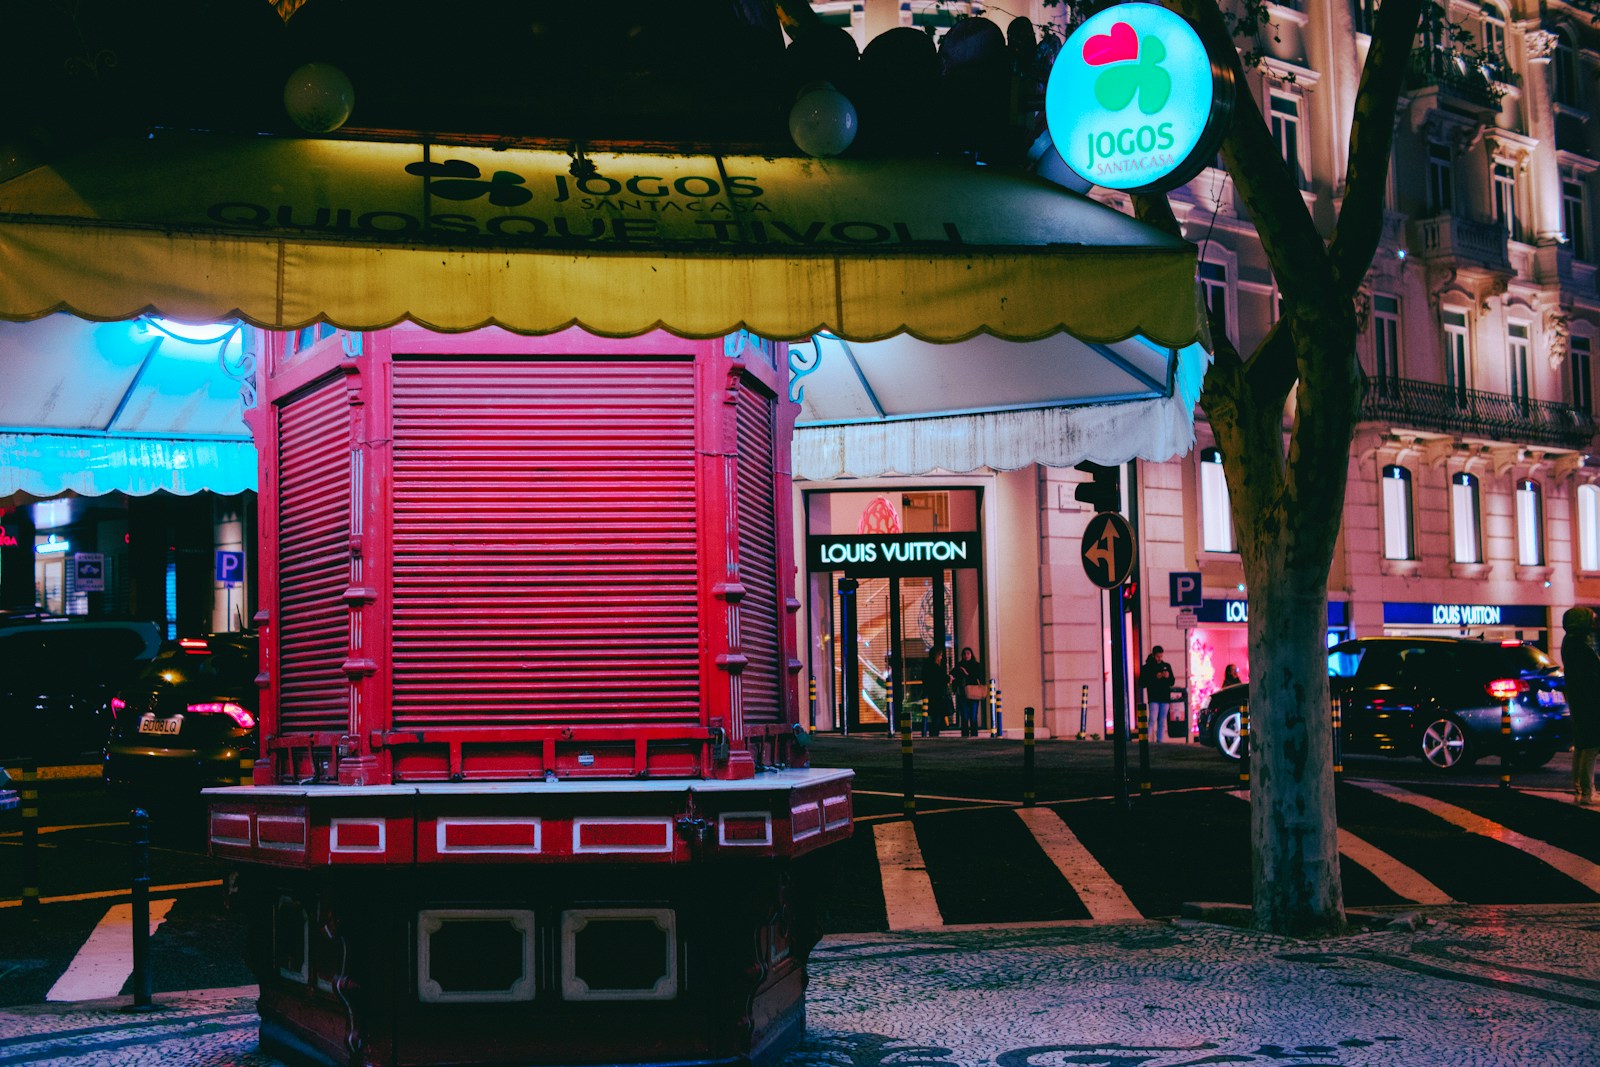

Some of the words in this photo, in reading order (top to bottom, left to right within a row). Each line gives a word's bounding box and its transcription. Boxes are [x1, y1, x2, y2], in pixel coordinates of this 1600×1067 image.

[1086, 122, 1175, 170] JOGOS
[1097, 153, 1175, 176] SANTACASA
[554, 174, 764, 202] JOGOS
[580, 197, 772, 213] SANTACASA
[206, 202, 660, 242] QUIOSQUE
[694, 219, 964, 244] TIVOLI
[821, 543, 877, 563] LOUIS
[881, 541, 967, 562] VUITTON
[222, 553, 239, 579] P
[1177, 577, 1195, 603] P
[1432, 605, 1460, 624] LOUIS
[1461, 605, 1501, 625] VUITTON
